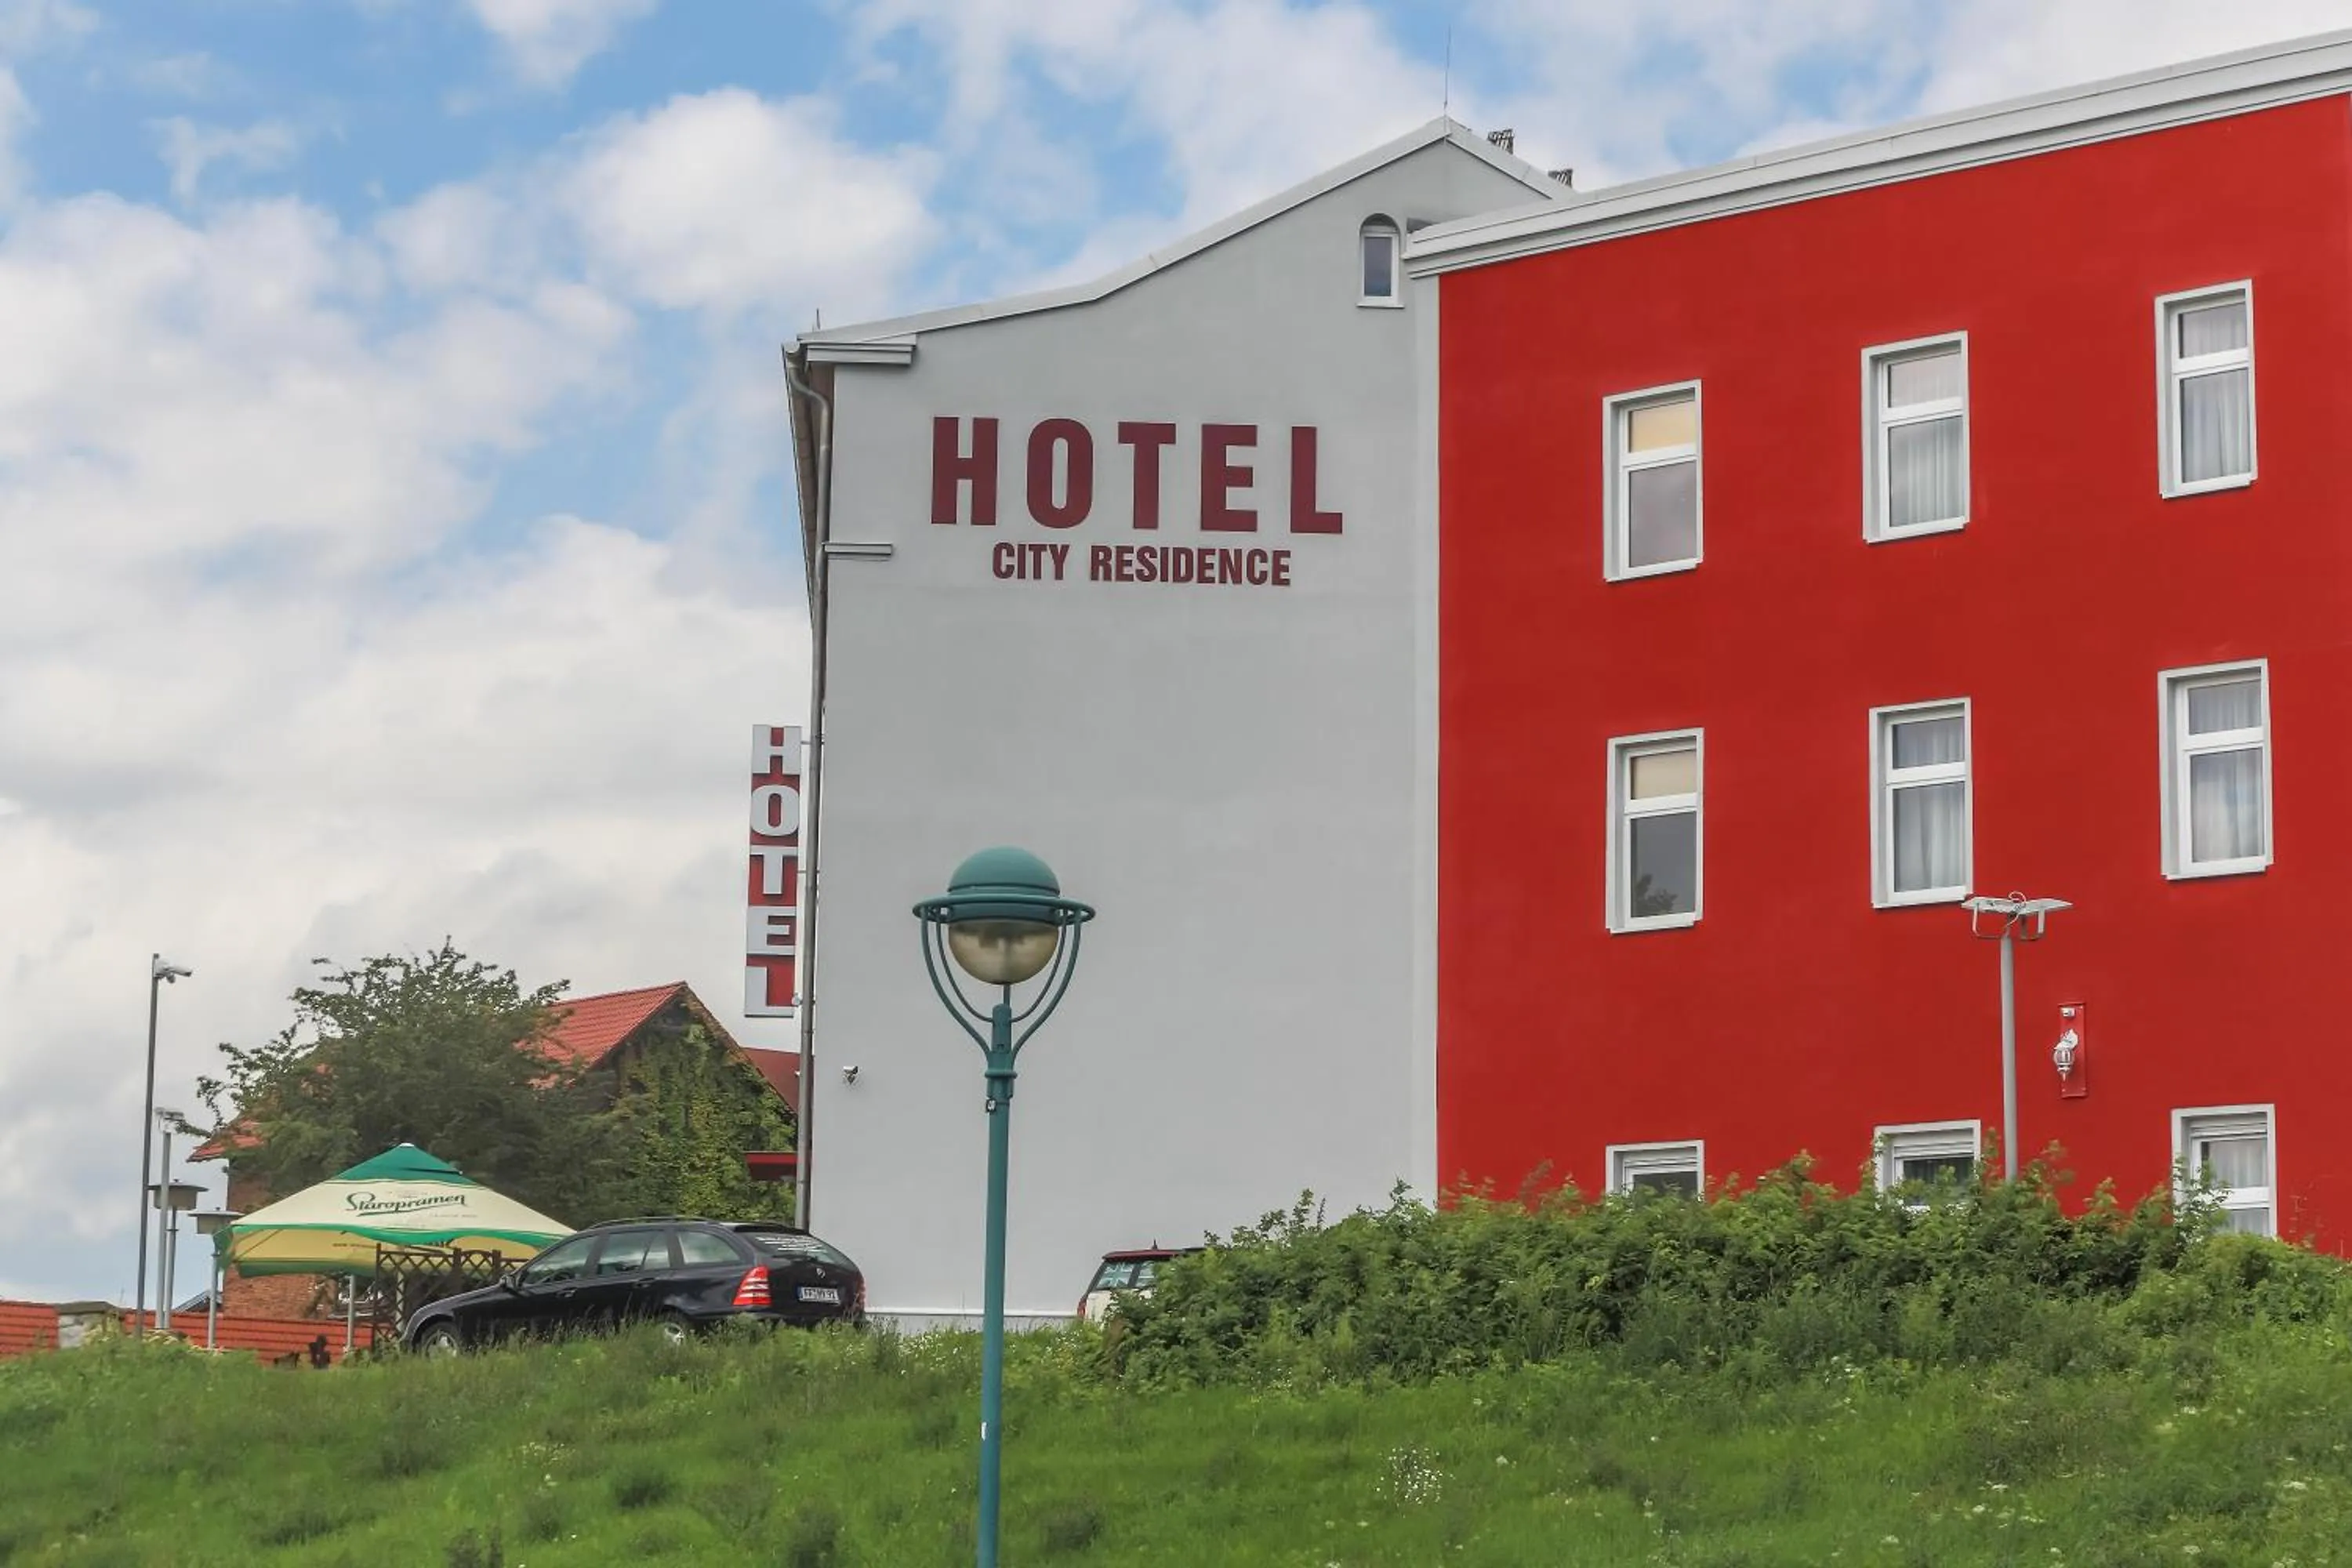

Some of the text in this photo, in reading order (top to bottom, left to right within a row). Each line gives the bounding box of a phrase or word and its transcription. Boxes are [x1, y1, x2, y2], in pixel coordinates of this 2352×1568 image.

[931, 416, 1343, 534] HOTEL
[993, 543, 1291, 586] CITY RESIDENCE
[744, 724, 802, 1018] HOTEL
[346, 1191, 468, 1214] Staropramen
